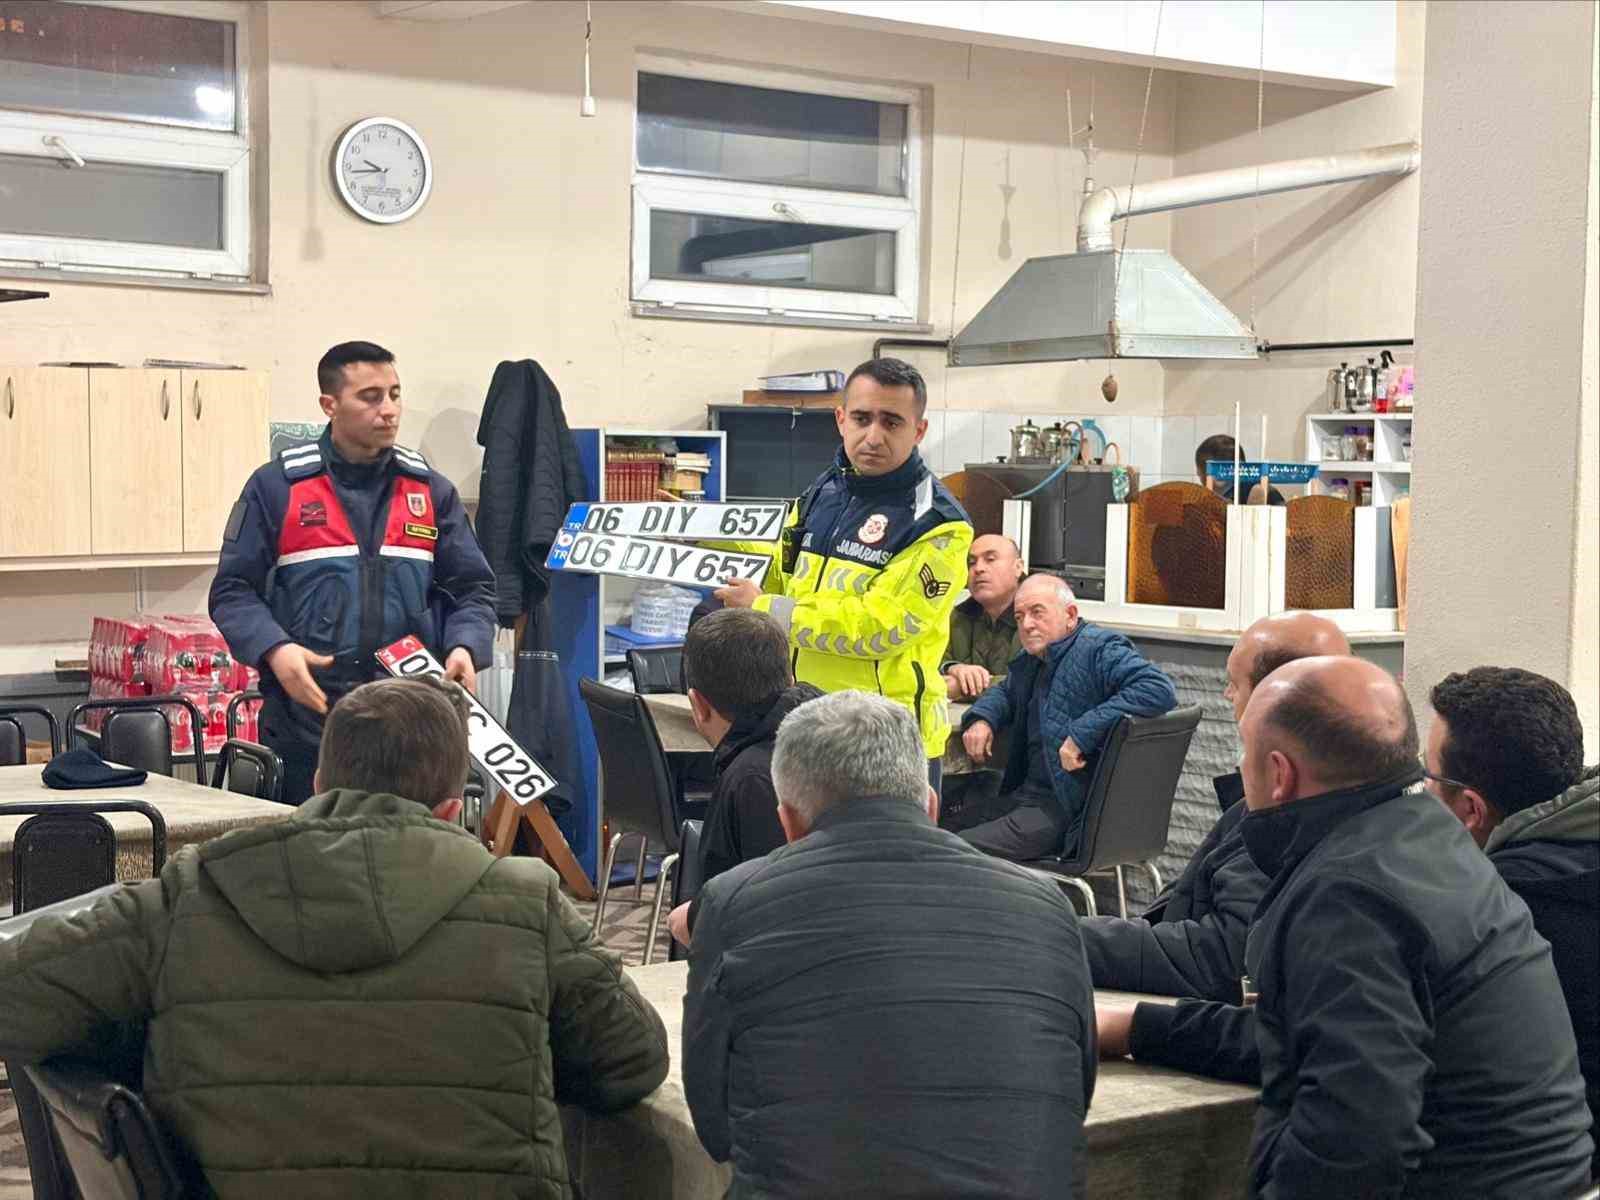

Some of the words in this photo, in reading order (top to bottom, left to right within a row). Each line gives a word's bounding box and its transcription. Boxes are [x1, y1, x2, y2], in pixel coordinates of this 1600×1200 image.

[569, 522, 582, 530] TR
[584, 507, 624, 532] 06
[638, 506, 698, 534] DIY
[719, 507, 783, 536] 657
[553, 550, 568, 560] TR
[569, 536, 615, 567] 06
[619, 542, 693, 577] DIY
[694, 554, 766, 585] 657
[398, 654, 442, 680] 0
[484, 743, 546, 799] 026
